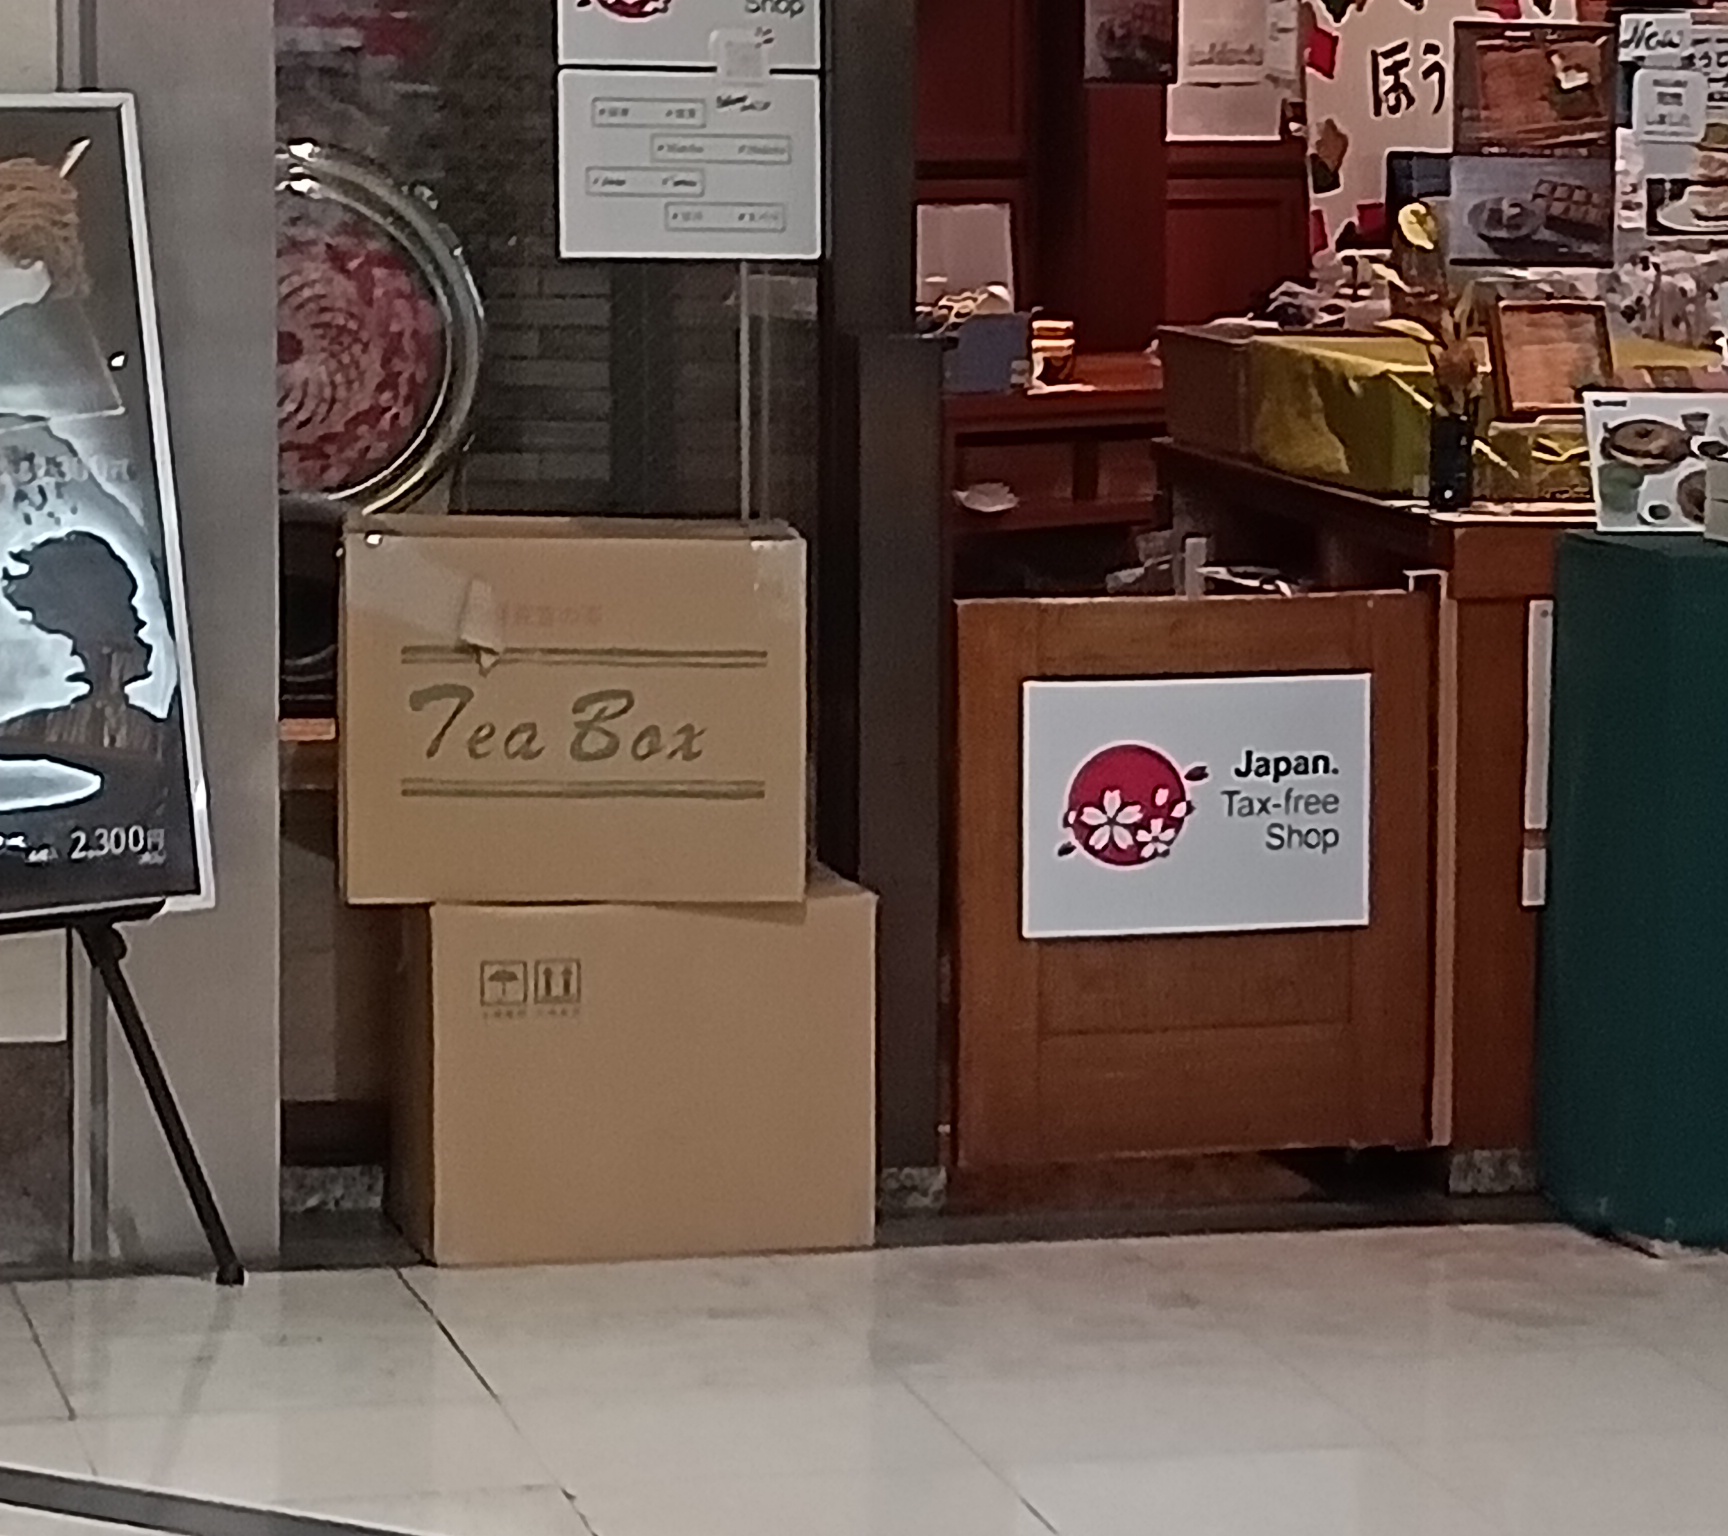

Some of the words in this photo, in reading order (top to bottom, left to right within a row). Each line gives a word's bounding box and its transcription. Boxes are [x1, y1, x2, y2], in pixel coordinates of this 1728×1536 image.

[408, 683, 546, 760] Tea
[569, 689, 708, 762] Box
[1234, 750, 1339, 782] Japan.
[1221, 788, 1340, 817] Tax-free
[1265, 823, 1340, 853] Shop
